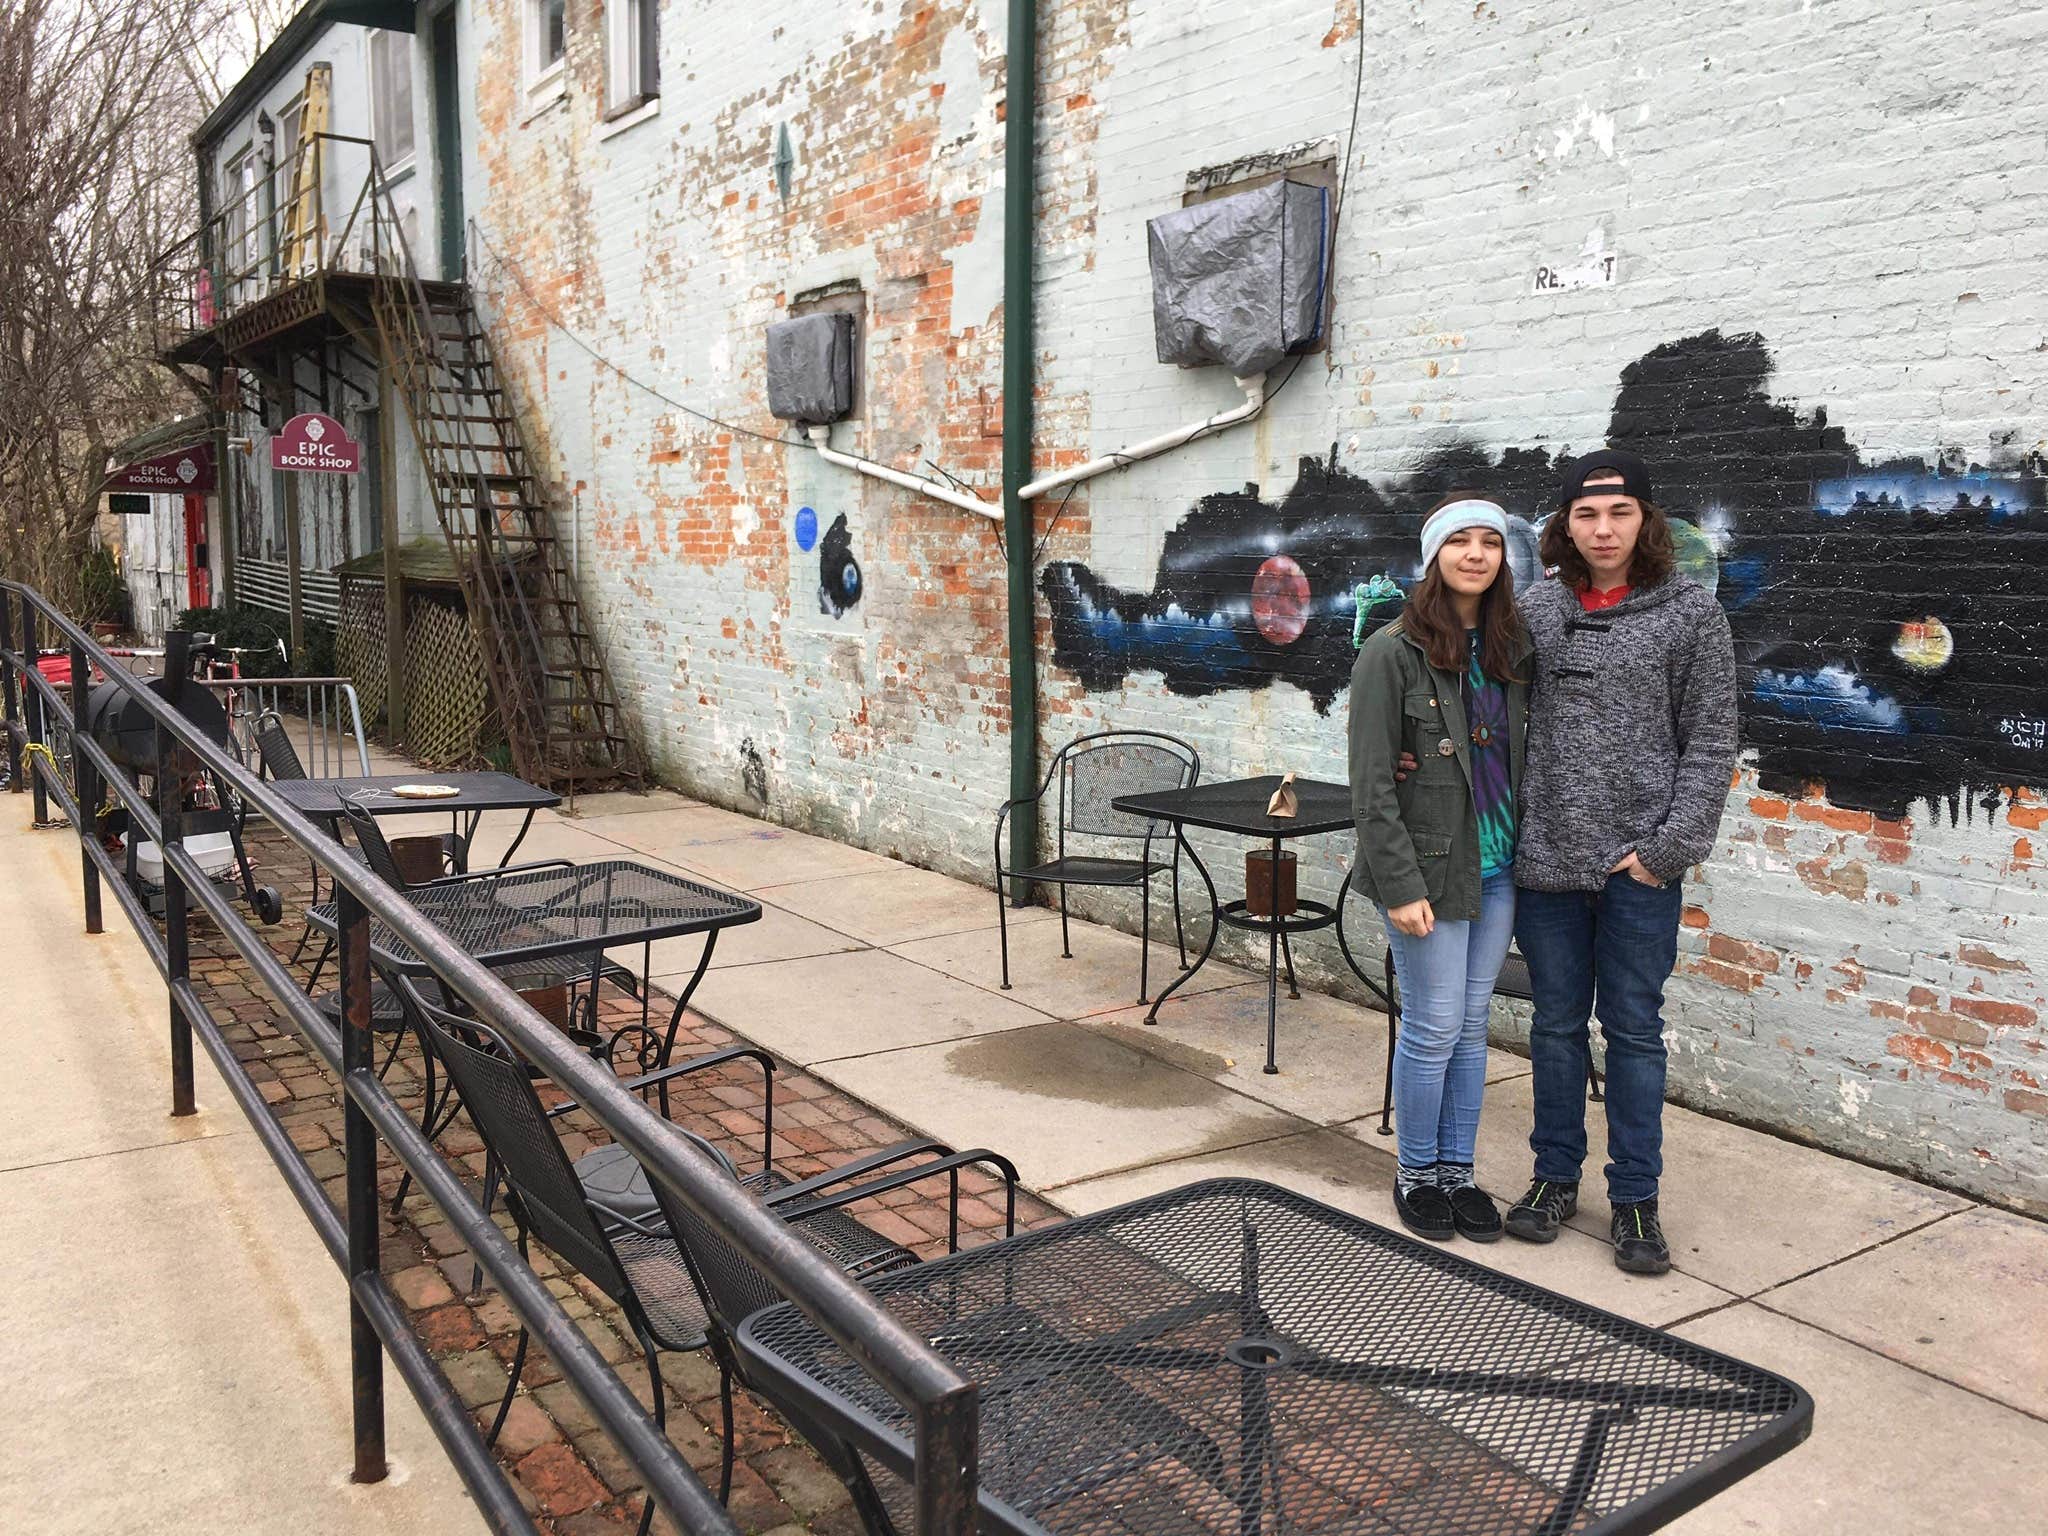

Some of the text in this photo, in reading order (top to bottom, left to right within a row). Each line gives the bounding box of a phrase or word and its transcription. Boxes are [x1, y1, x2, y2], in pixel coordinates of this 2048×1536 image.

[1535, 256, 1615, 290] RET
[299, 441, 336, 456] EPIC
[281, 455, 352, 468] BOOK SHOP
[141, 465, 167, 476] EPIC
[129, 475, 179, 485] BOOK SHOP
